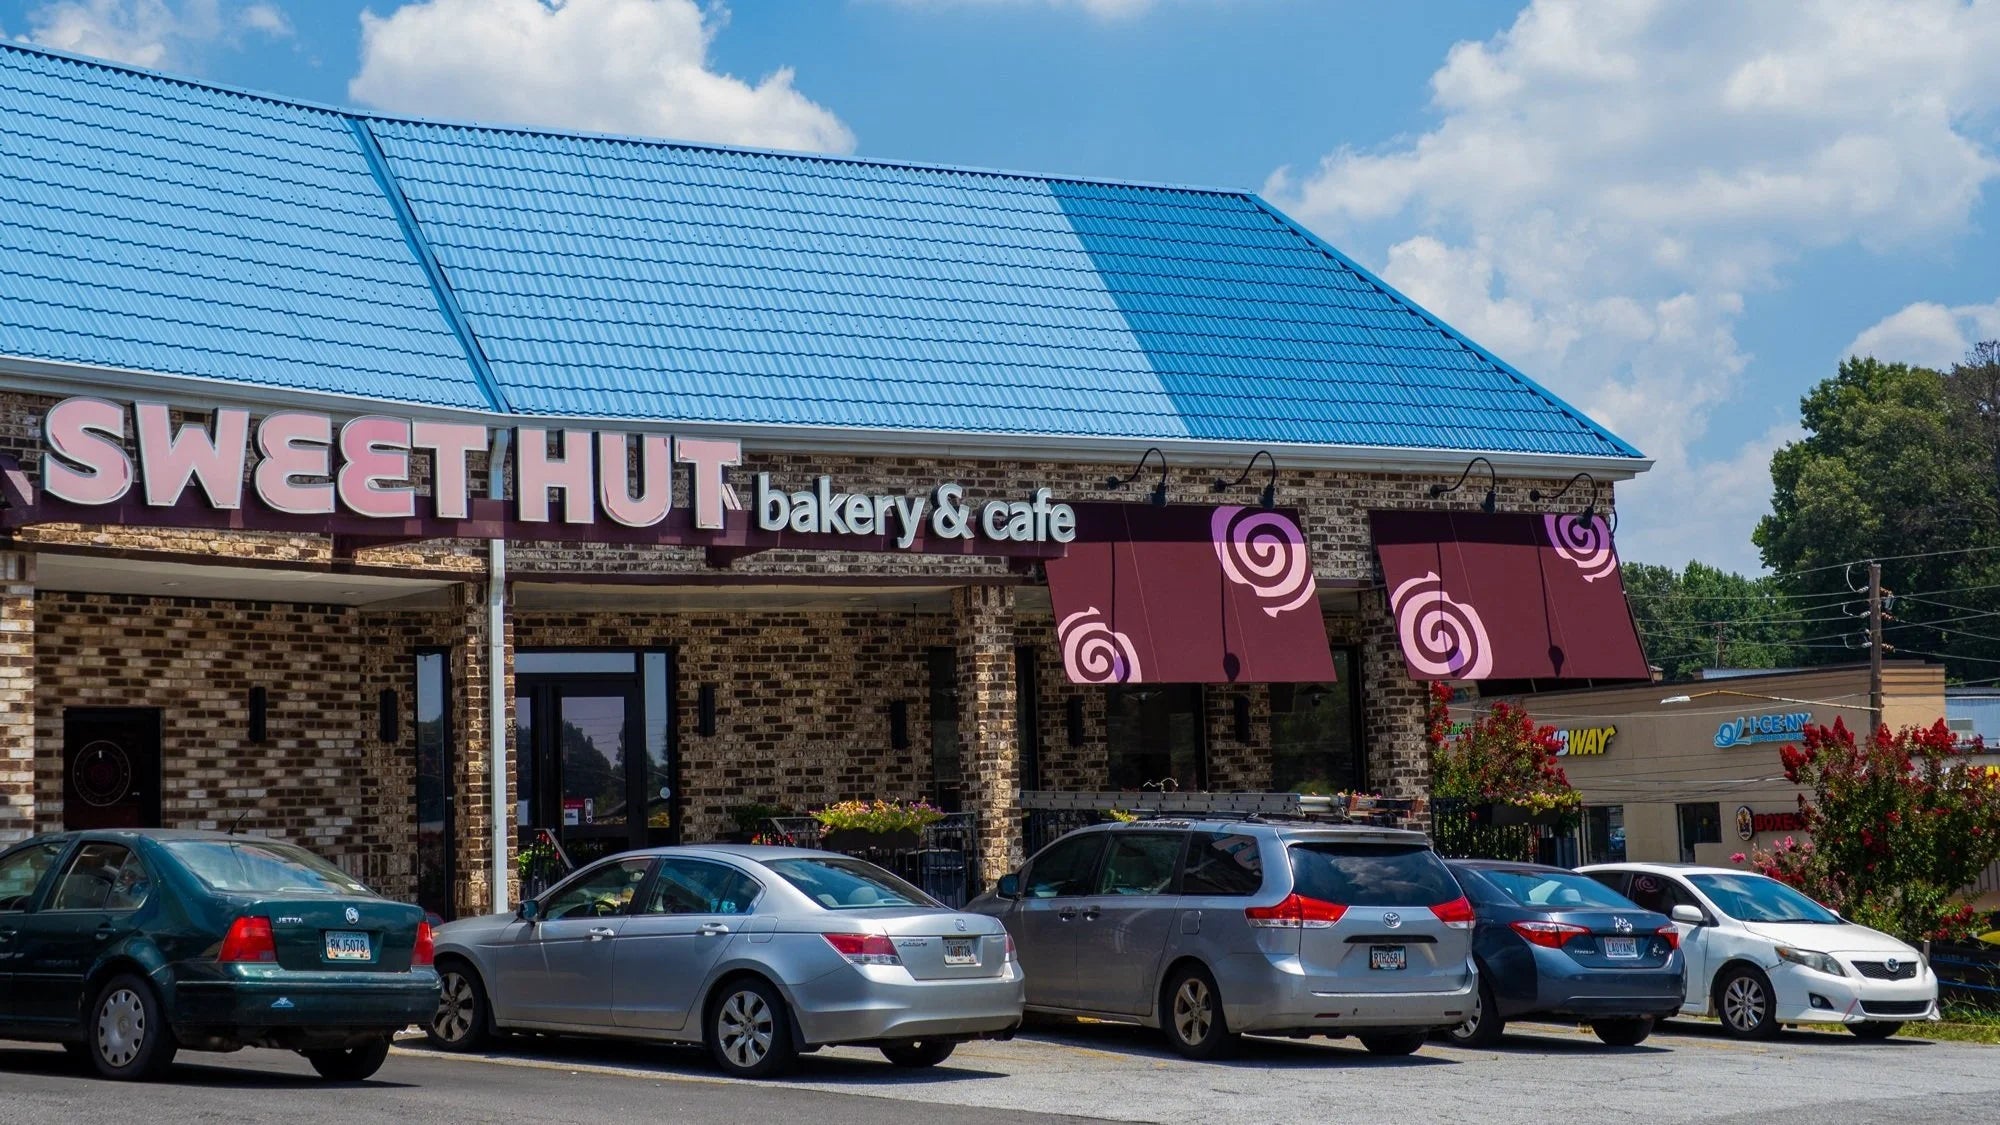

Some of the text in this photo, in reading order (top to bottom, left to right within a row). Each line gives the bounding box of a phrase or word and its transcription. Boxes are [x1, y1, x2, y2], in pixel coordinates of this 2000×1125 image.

[45, 395, 1077, 549] SWEET HUT bakery & cafe
[1545, 726, 1616, 756] BWAY
[330, 938, 366, 953] RKJ5078
